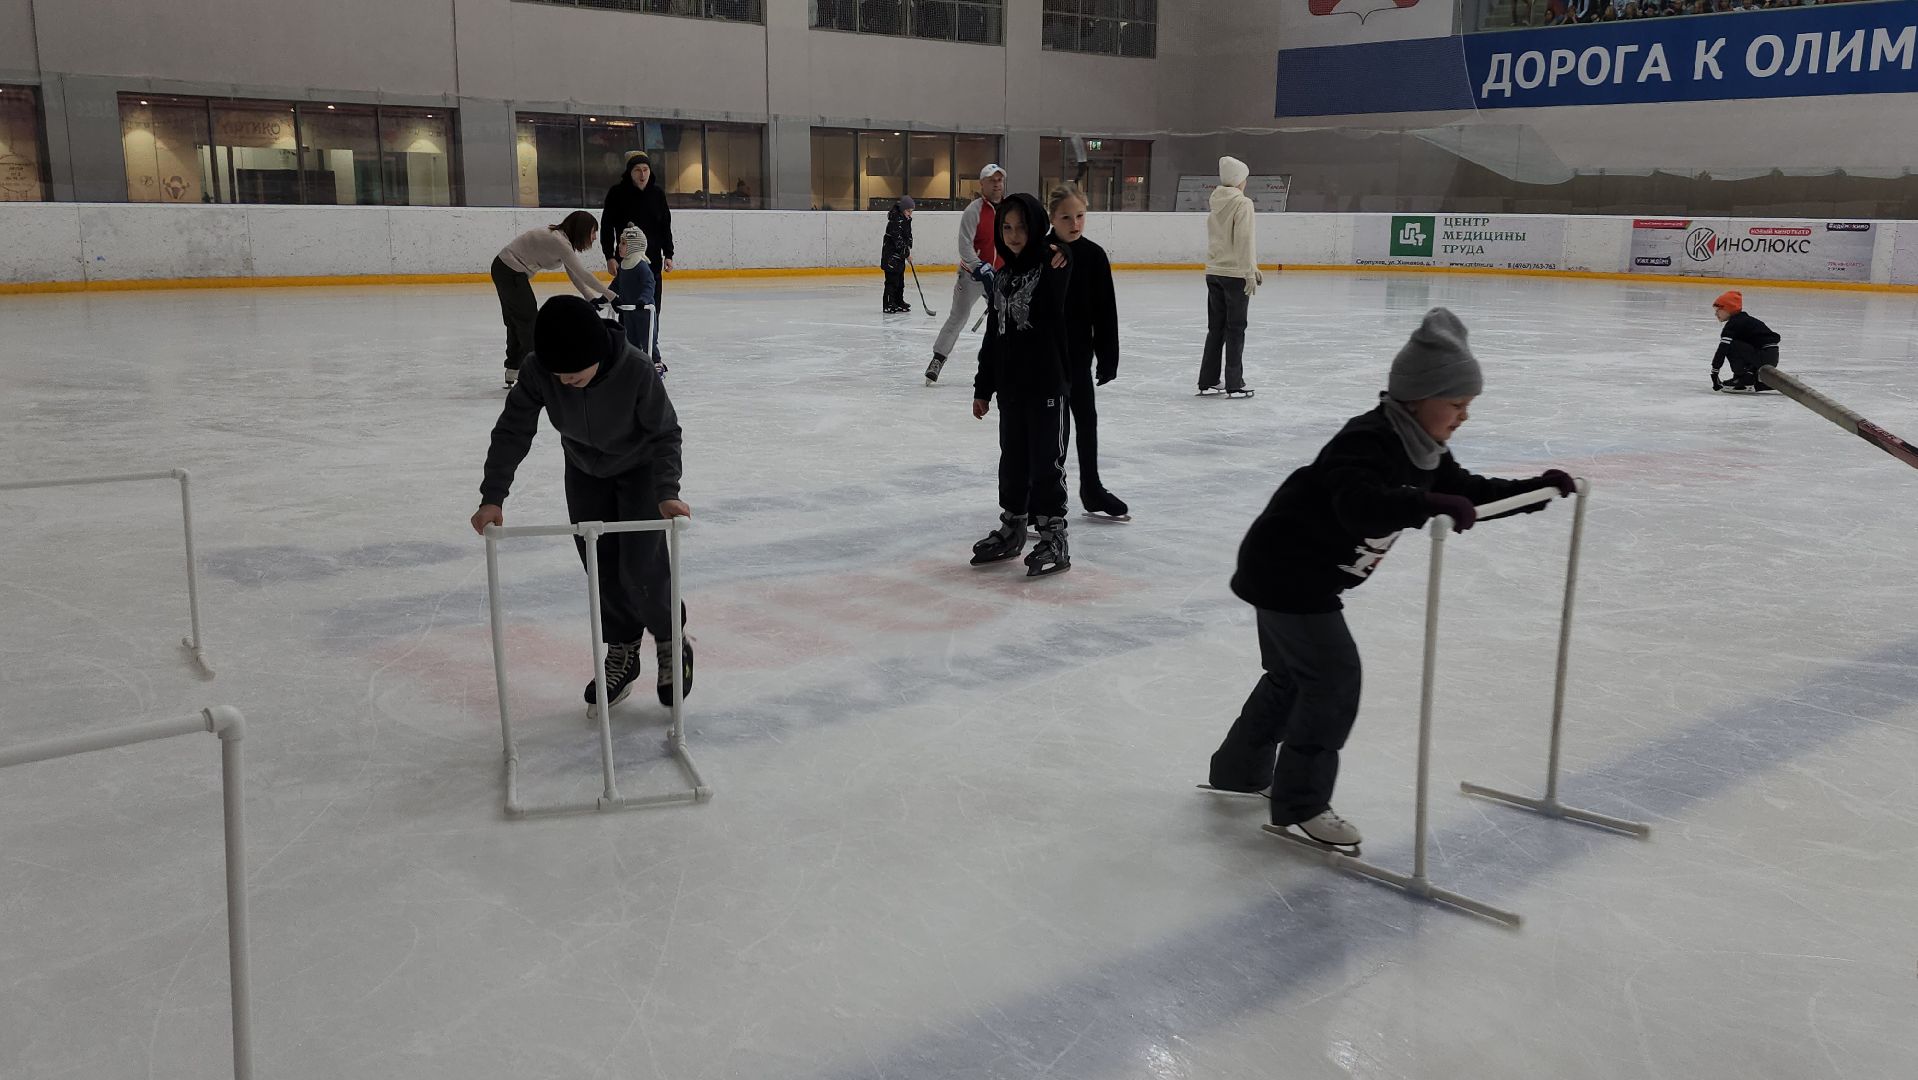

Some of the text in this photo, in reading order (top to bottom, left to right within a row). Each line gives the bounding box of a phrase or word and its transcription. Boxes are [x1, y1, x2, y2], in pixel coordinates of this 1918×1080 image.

[1481, 25, 1917, 98] ДОРОГА К ОЛИМ
[1443, 217, 1490, 228] ЦЕНТР
[1441, 231, 1526, 242] МЕДИЦИНЫ
[1441, 244, 1485, 255] ТРУДА
[1685, 227, 1811, 262] КИНОЛЮКС
